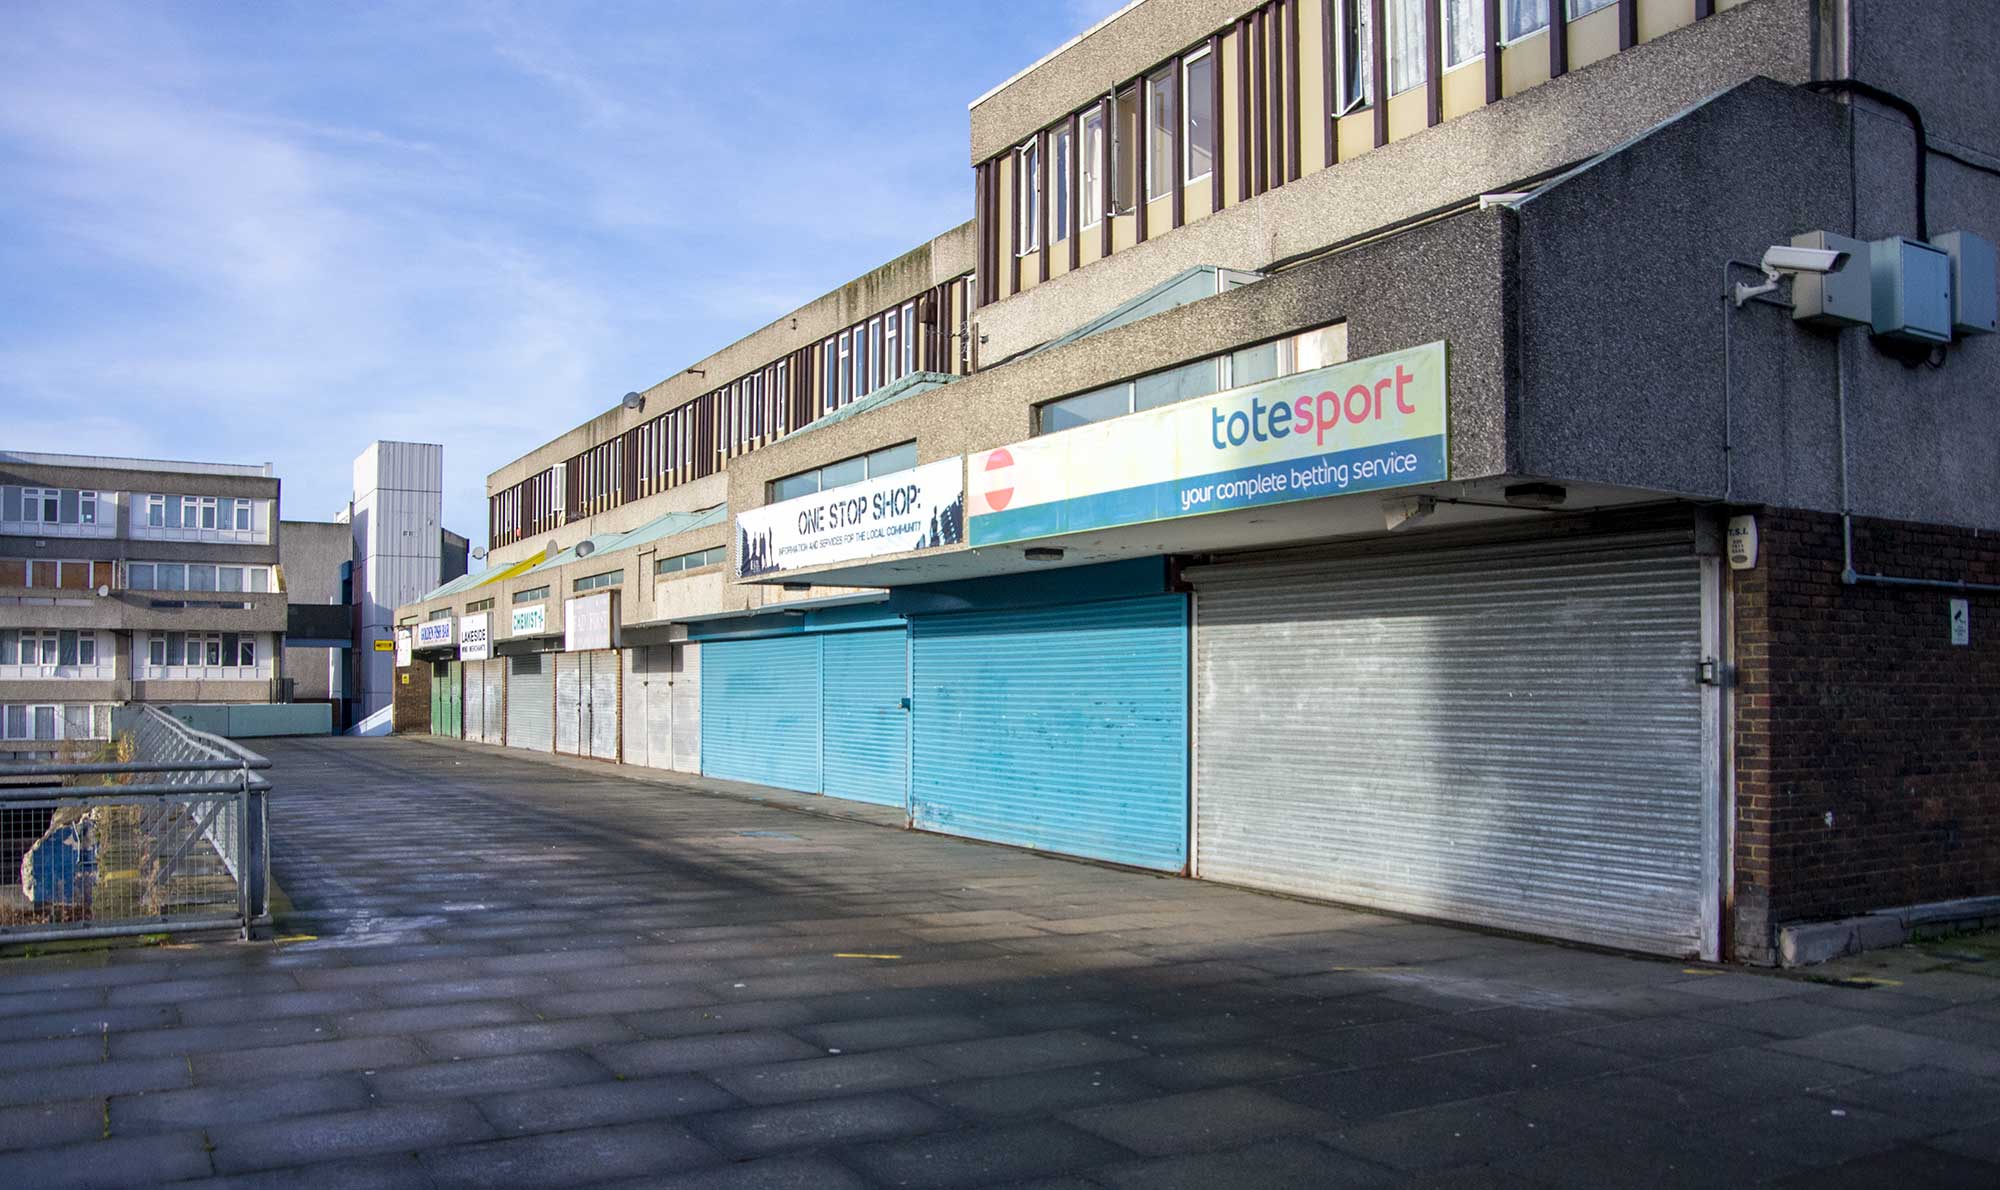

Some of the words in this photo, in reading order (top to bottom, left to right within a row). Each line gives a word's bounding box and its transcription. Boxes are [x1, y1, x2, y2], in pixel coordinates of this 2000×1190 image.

[1212, 364, 1416, 450] totesport
[1181, 485, 1214, 511] your
[1216, 472, 1287, 500] complete
[1290, 458, 1349, 489] betting
[1352, 451, 1418, 480] service
[798, 507, 825, 536] ONE
[829, 496, 867, 529] STOP
[872, 484, 921, 521] SHOP:
[778, 543, 809, 557] INFORMATION
[808, 541, 819, 551] AND
[819, 536, 843, 549] SERVICES
[844, 533, 854, 544] FOR
[855, 530, 866, 541] THE
[866, 527, 886, 540] LOCAL
[886, 520, 921, 537] COMMUNITY
[461, 628, 486, 643] LAKESIDE
[513, 610, 538, 630] CHEMIST
